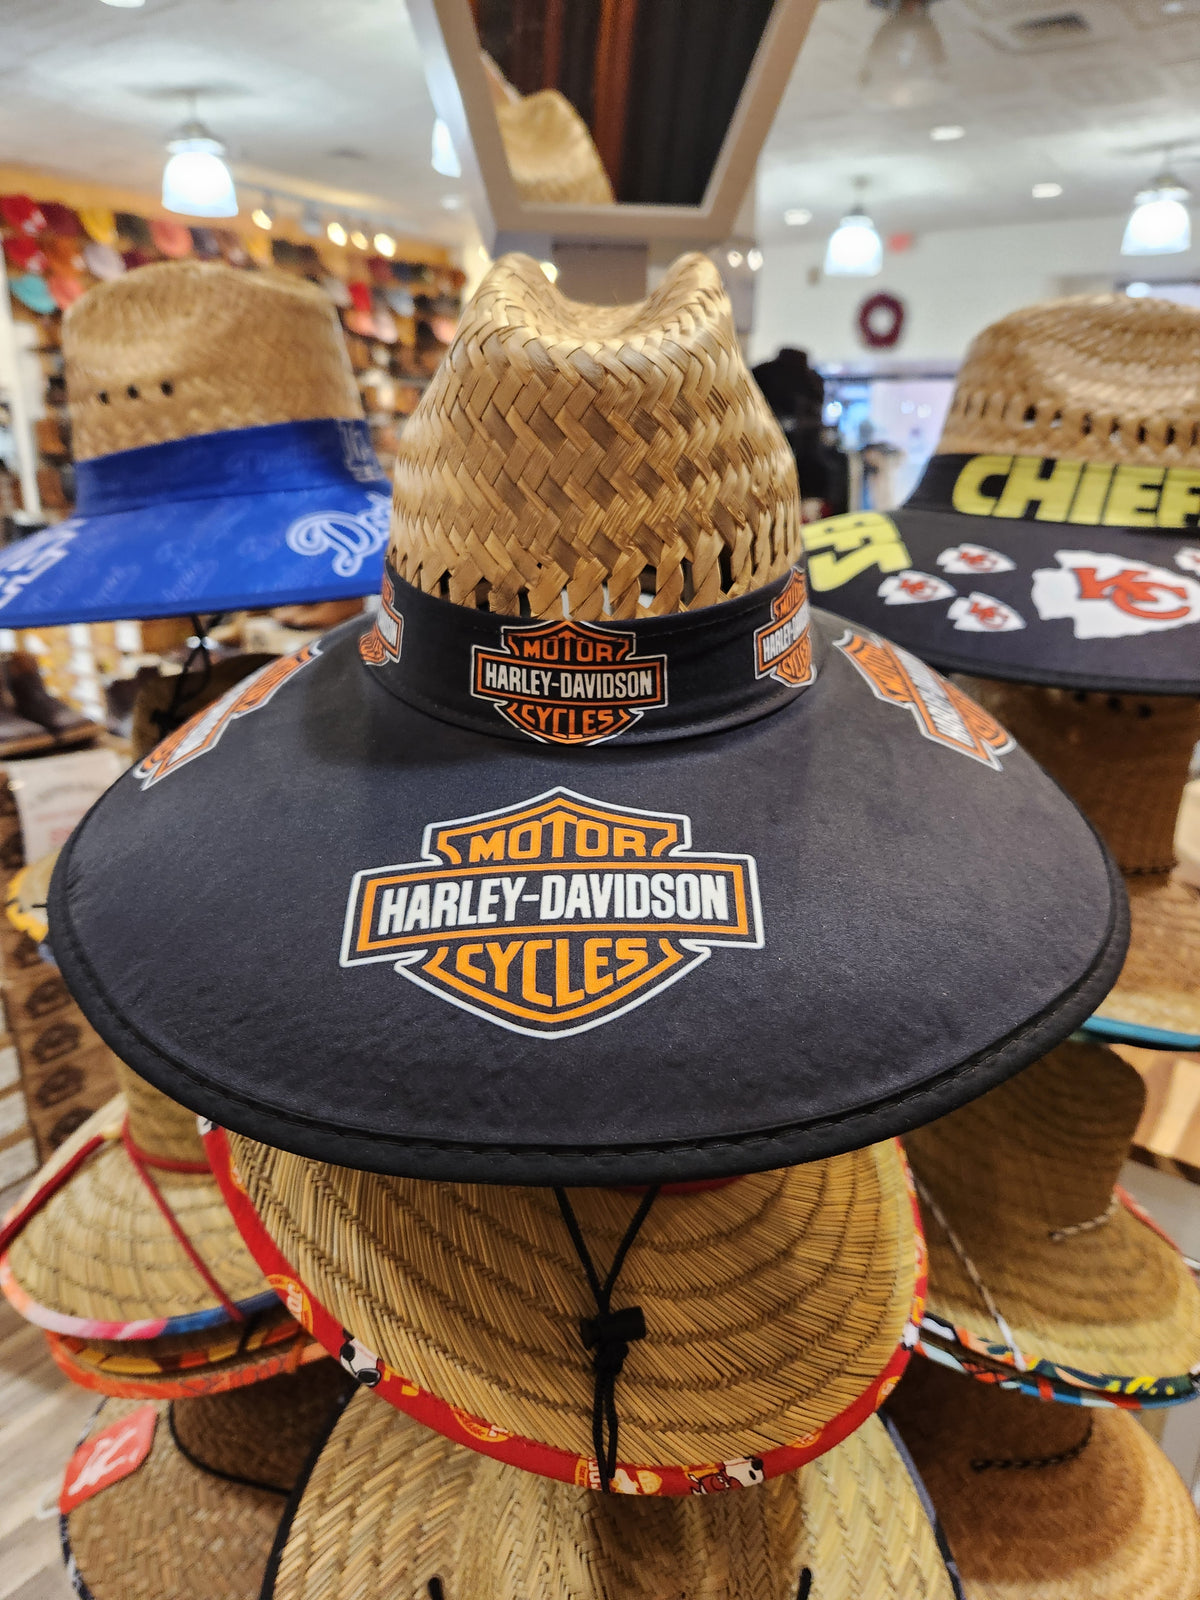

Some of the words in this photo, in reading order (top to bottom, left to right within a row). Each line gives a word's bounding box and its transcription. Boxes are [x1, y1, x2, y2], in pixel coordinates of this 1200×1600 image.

[1072, 566, 1190, 620] KC
[523, 630, 613, 662] MOTOR
[485, 662, 653, 699] HARLEY-DAVIDSON
[521, 704, 614, 739] CYCLES
[469, 810, 647, 863] MOTOR
[377, 873, 729, 935] HARLEY-DAVIDSON
[456, 937, 649, 1007] CYCLES
